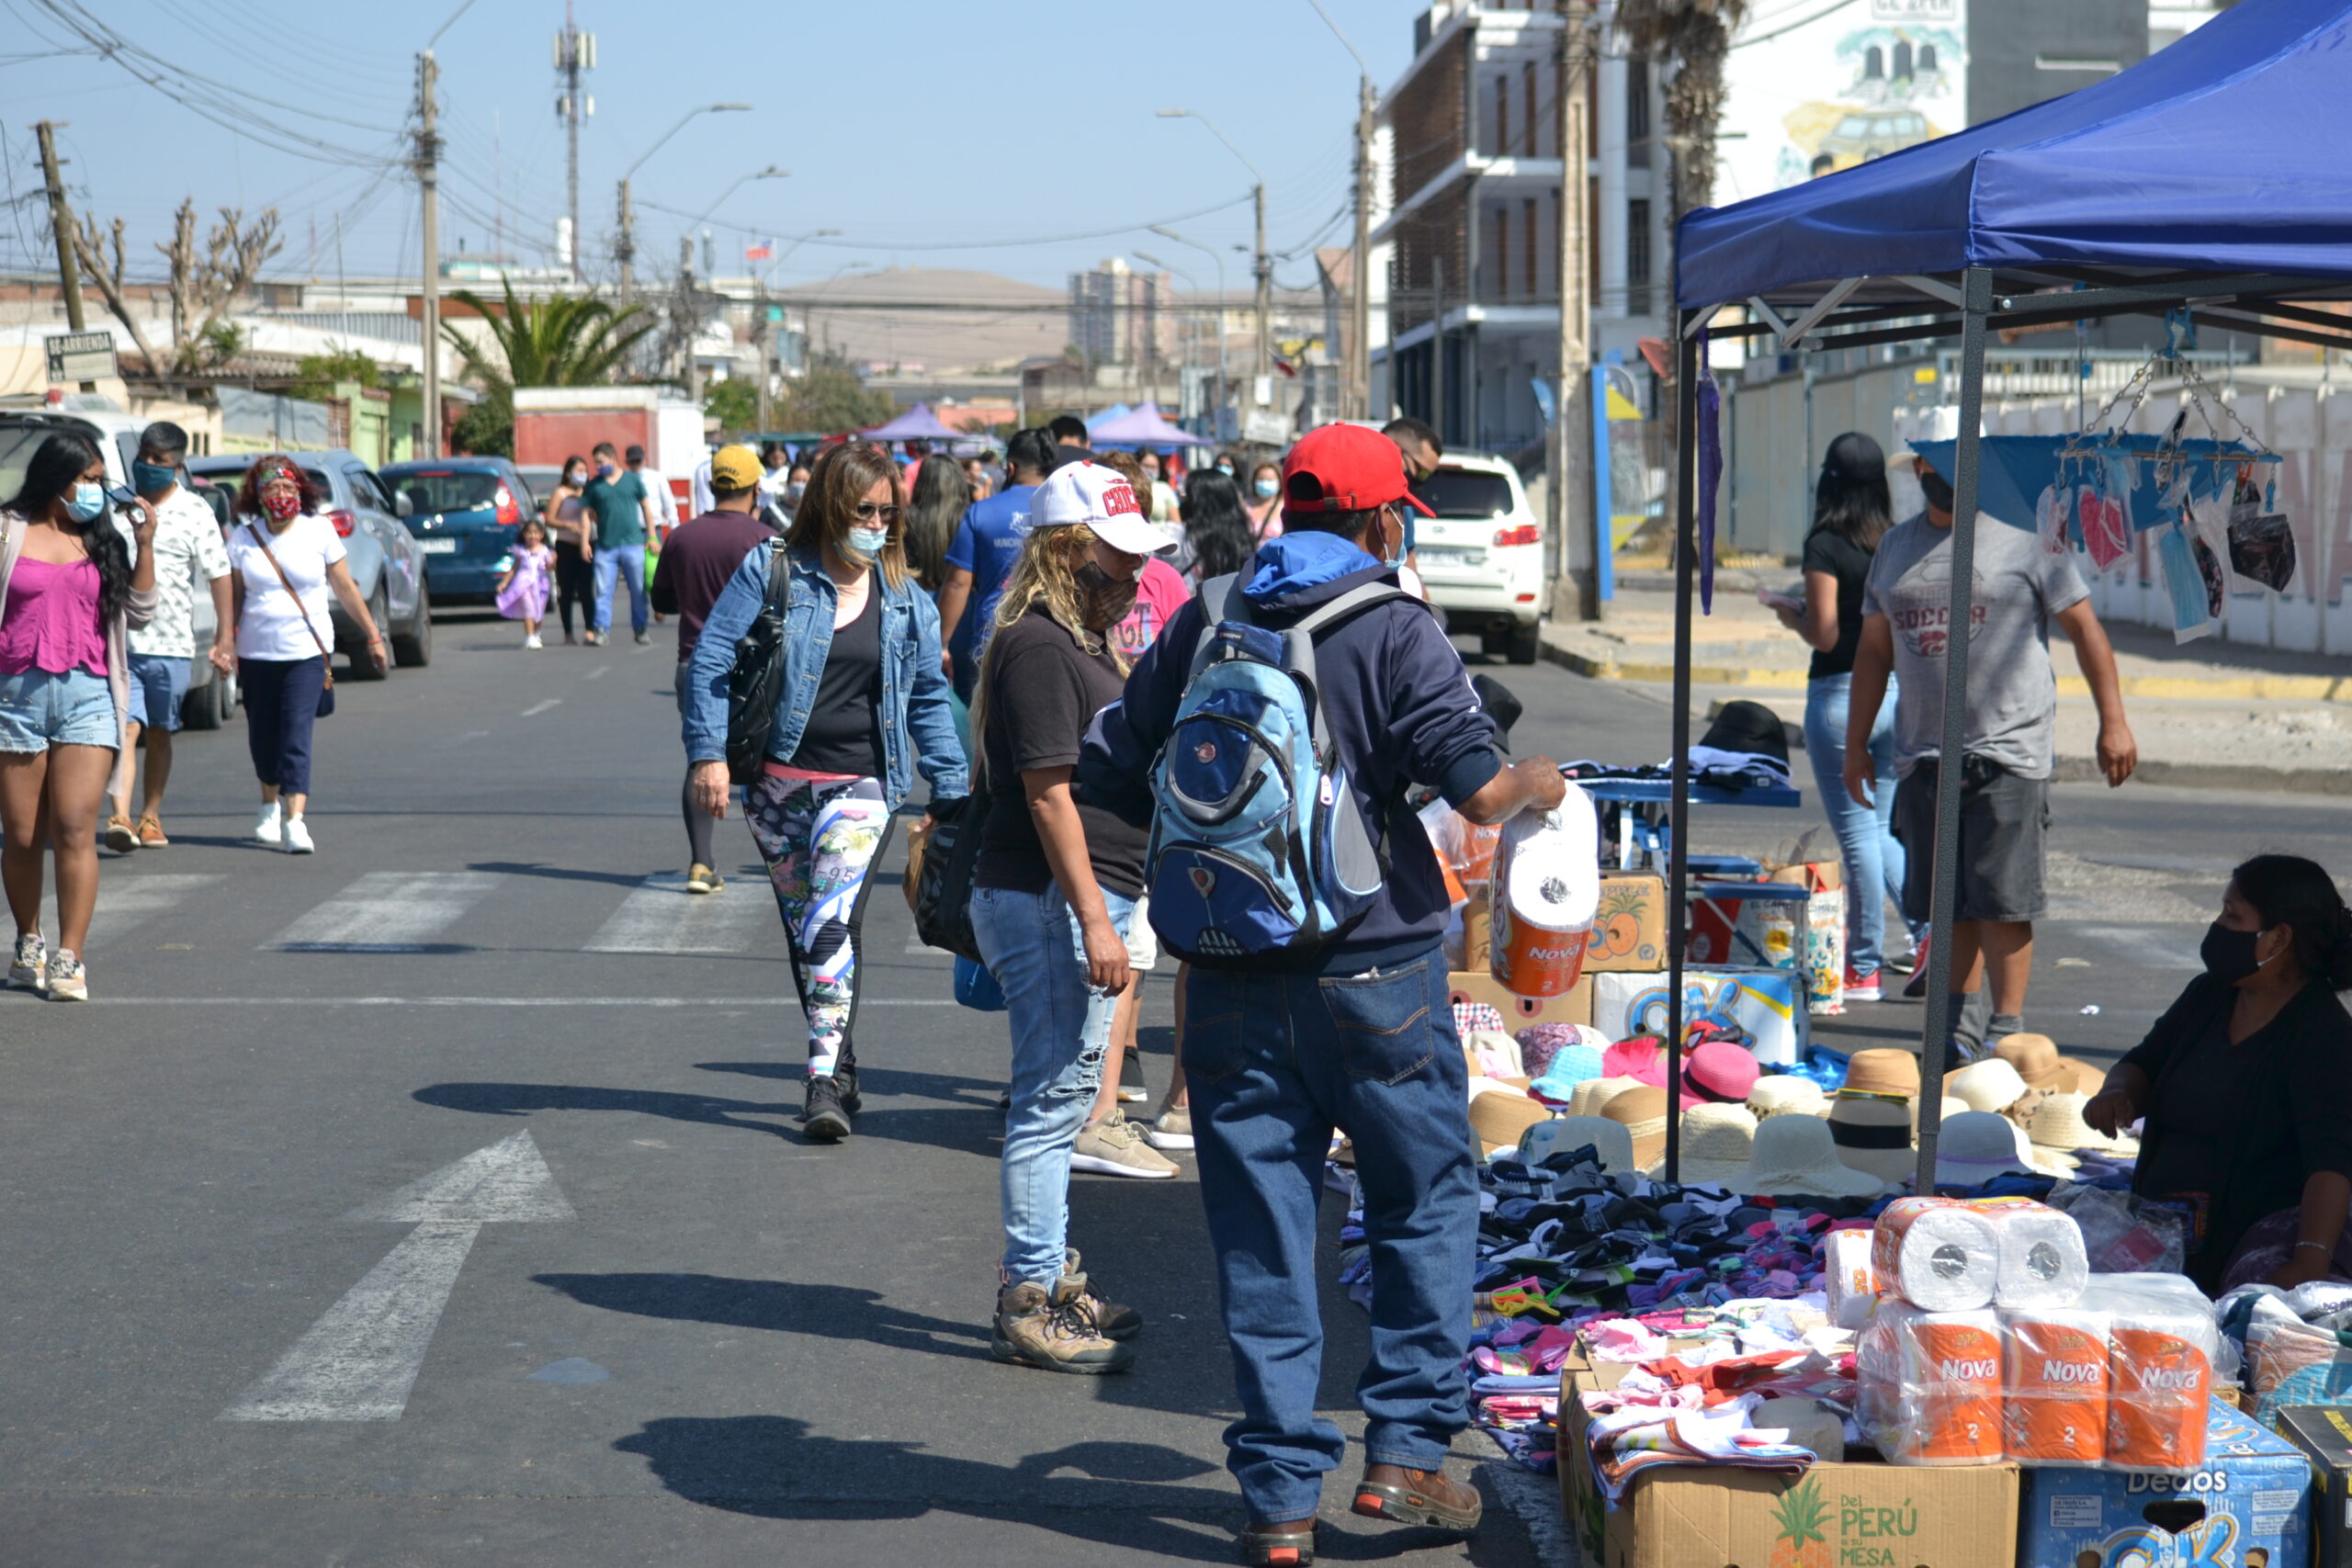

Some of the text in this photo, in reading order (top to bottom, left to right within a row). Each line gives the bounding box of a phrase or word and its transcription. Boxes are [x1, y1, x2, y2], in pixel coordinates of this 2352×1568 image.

[62, 333, 110, 354] ARRIENDA
[1893, 604, 1986, 631] SOCCR
[1475, 828, 1501, 839] Nov
[1529, 942, 1581, 961] Nova
[1940, 1358, 1996, 1382] Nova
[2042, 1359, 2100, 1382] Nova
[2142, 1366, 2199, 1391] Nova
[1967, 1423, 1980, 1439] 2
[2064, 1426, 2076, 1442] 2
[2162, 1433, 2175, 1450] 2
[1840, 1495, 1862, 1506] Del
[1840, 1497, 1917, 1537] PERÚ
[1840, 1547, 1895, 1566] MESA
